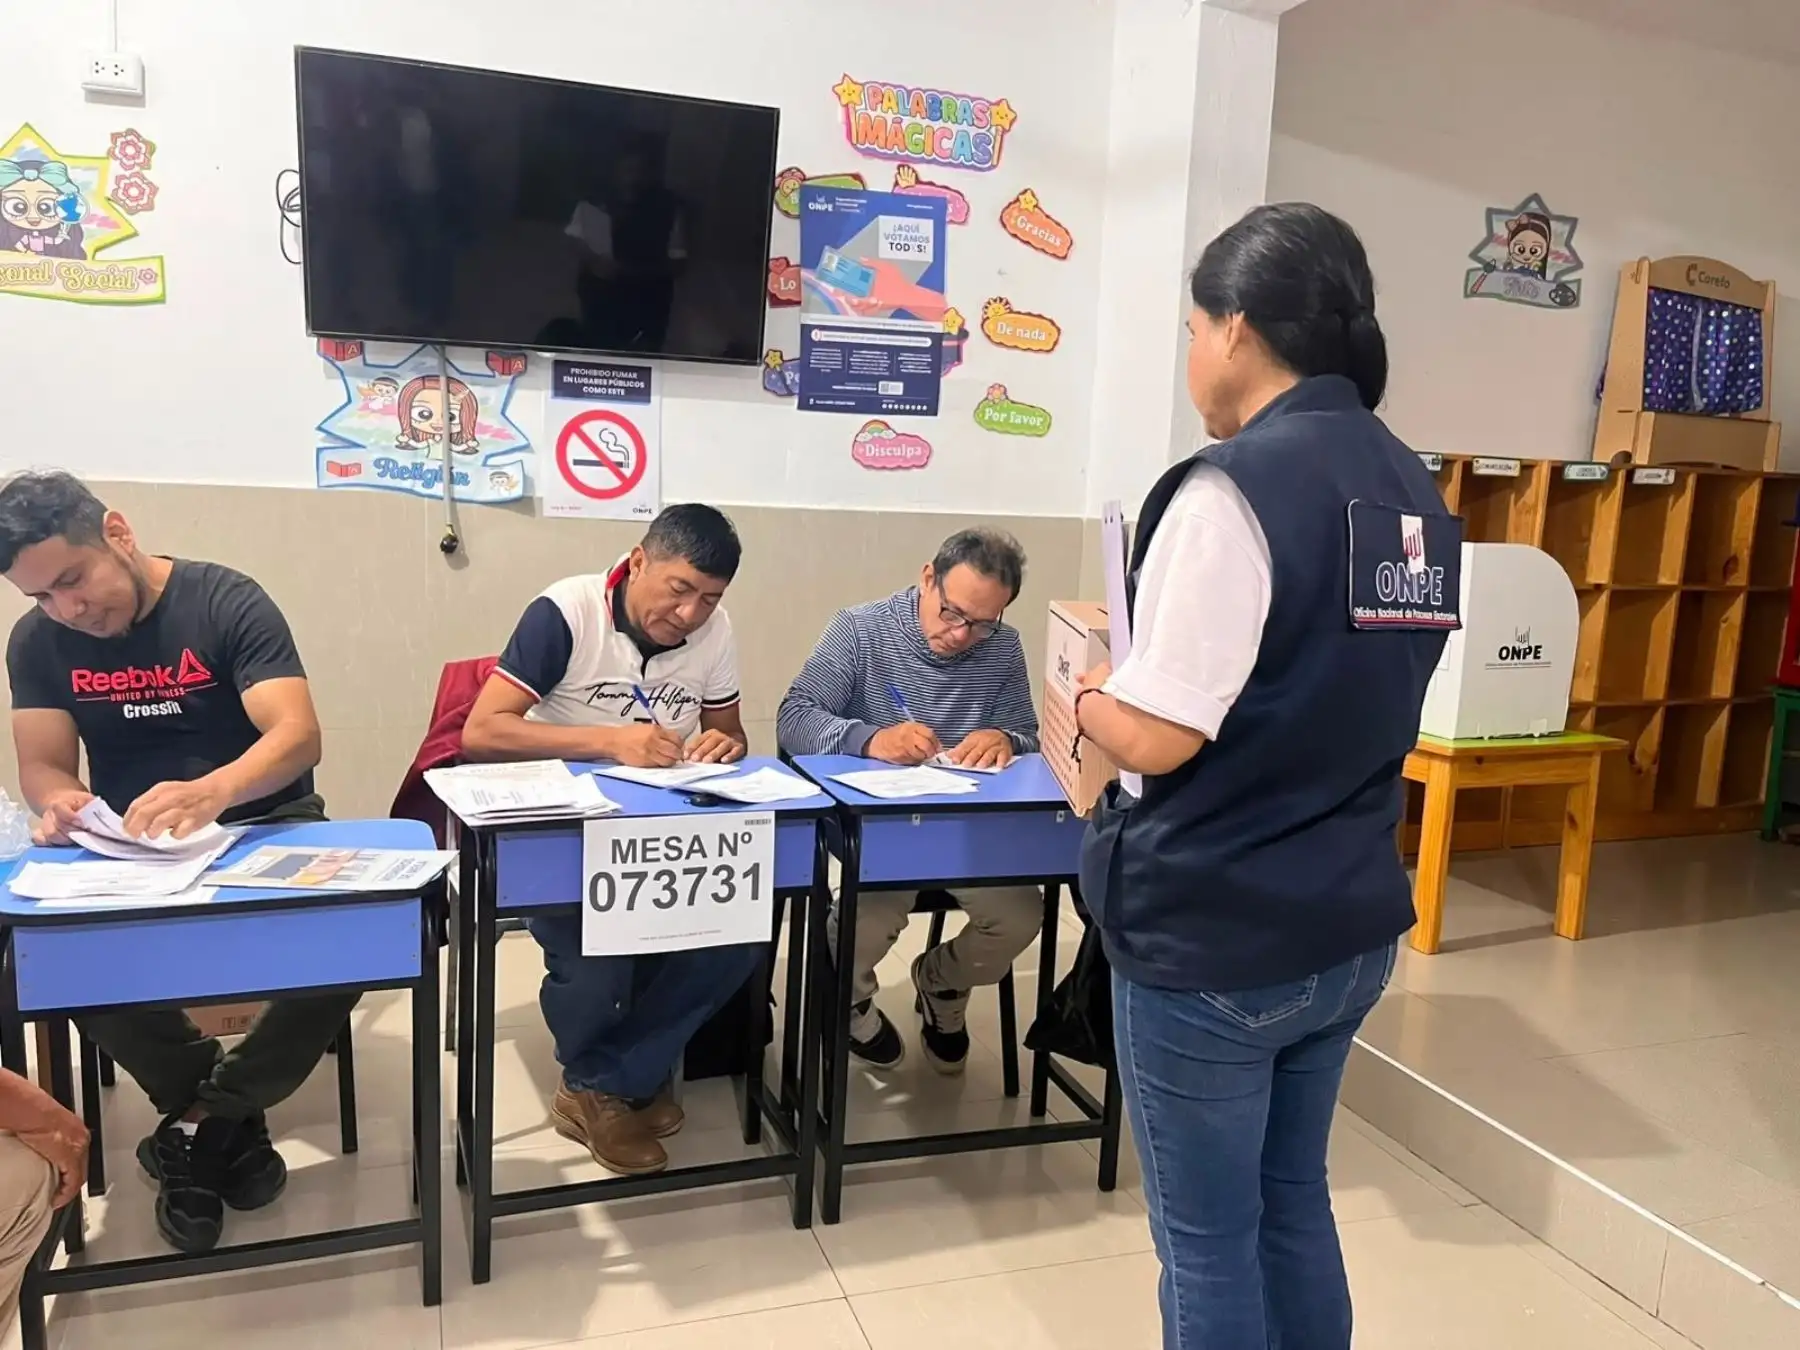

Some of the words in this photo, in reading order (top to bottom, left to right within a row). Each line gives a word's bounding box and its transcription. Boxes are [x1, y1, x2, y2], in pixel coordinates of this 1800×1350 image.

[866, 85, 990, 129] PALABRAS
[857, 112, 993, 165] MÁGICAS
[884, 232, 930, 243] VOTAMOS
[1016, 215, 1062, 247] Gracias
[58, 262, 136, 291] Social
[780, 276, 796, 290] Lo
[996, 321, 1012, 335] De
[1016, 327, 1046, 341] nada
[563, 376, 574, 384] EN
[574, 376, 608, 386] LUGARES
[608, 377, 645, 389] PÚBLICOS
[570, 367, 611, 378] PROHIBIDO
[612, 371, 638, 379] FUMAR
[583, 386, 607, 394] COMO
[608, 388, 625, 396] ESTE
[984, 407, 1007, 422] Por
[1009, 411, 1043, 426] favor
[865, 443, 922, 458] Disculpa
[1375, 561, 1444, 606] ONPE
[1498, 644, 1543, 661] ONPE
[110, 691, 142, 701] UNITED
[585, 682, 640, 717] Tommy
[647, 682, 700, 721] Hilfiger
[611, 834, 708, 865] MESA
[718, 831, 753, 857] Nº
[588, 862, 760, 913] 073731
